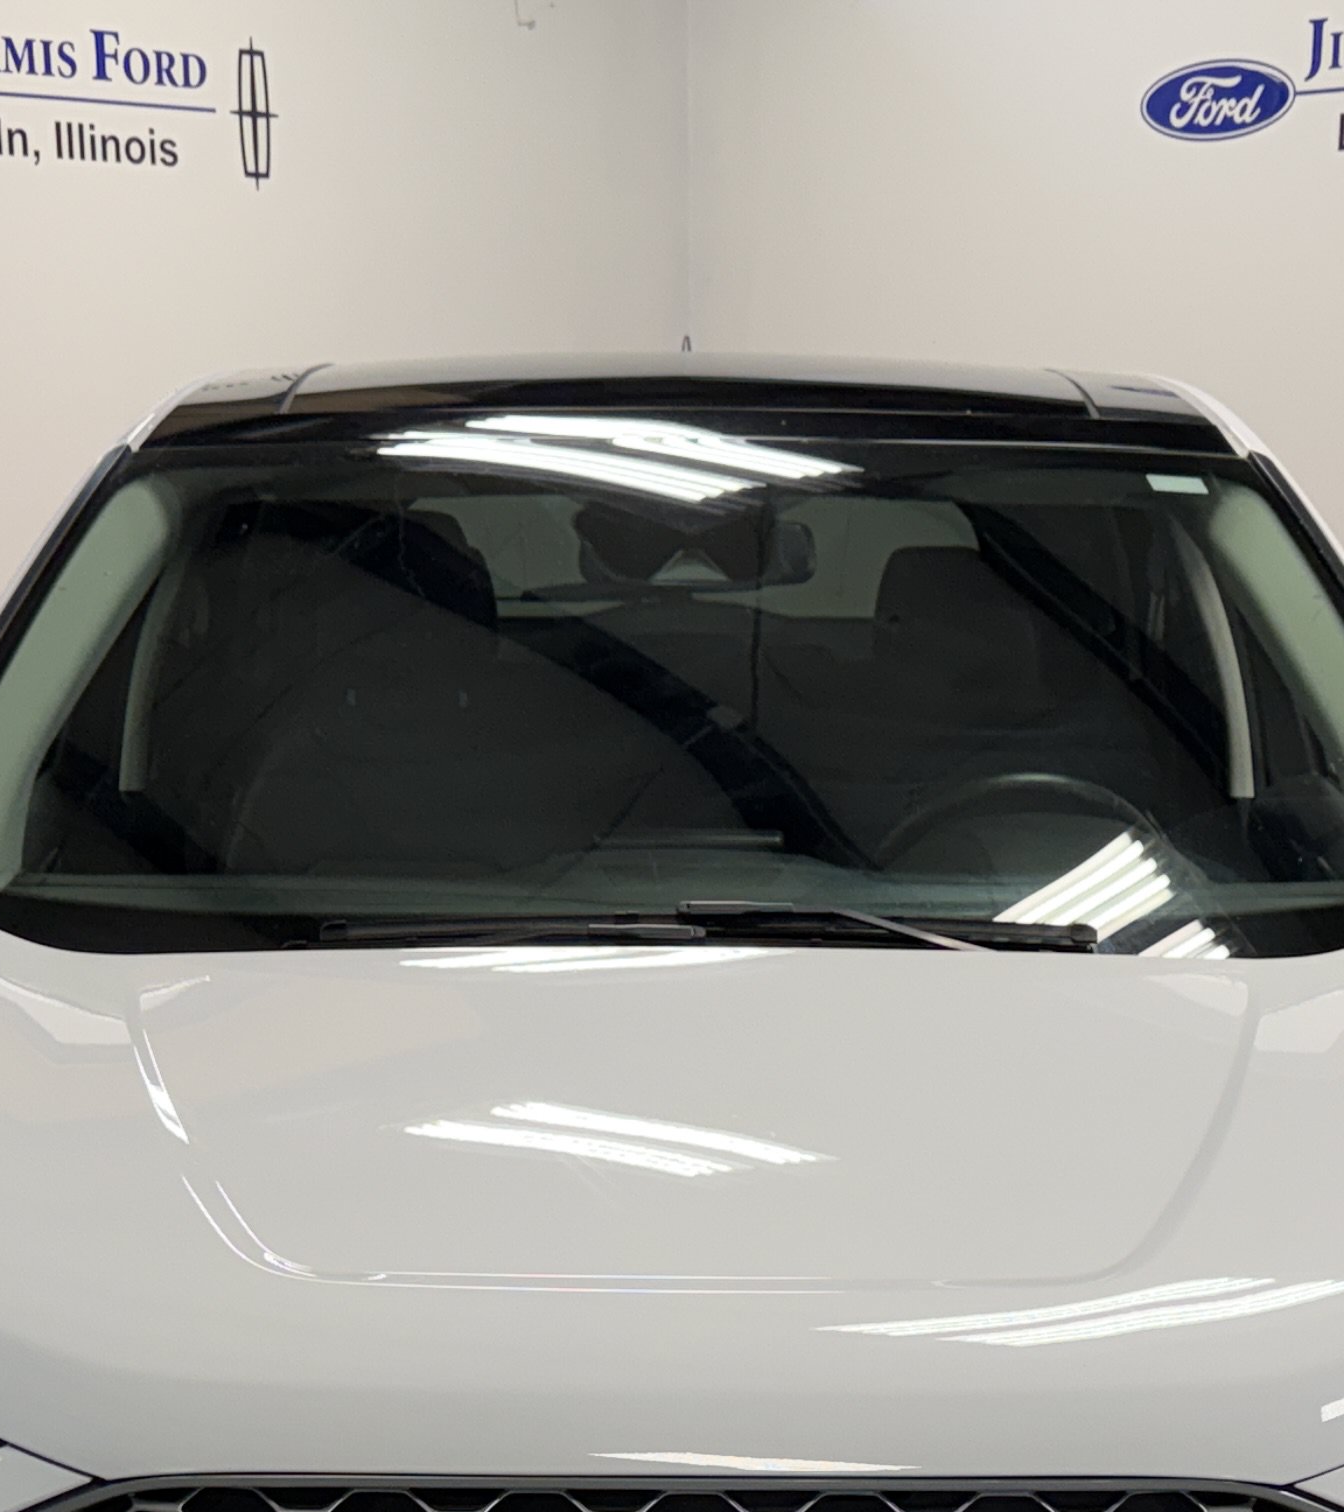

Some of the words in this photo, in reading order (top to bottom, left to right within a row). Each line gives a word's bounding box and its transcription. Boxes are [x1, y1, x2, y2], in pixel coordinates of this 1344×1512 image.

[90, 28, 208, 88] FORD
[1168, 76, 1260, 126] Ford
[54, 121, 179, 167] Illinois
